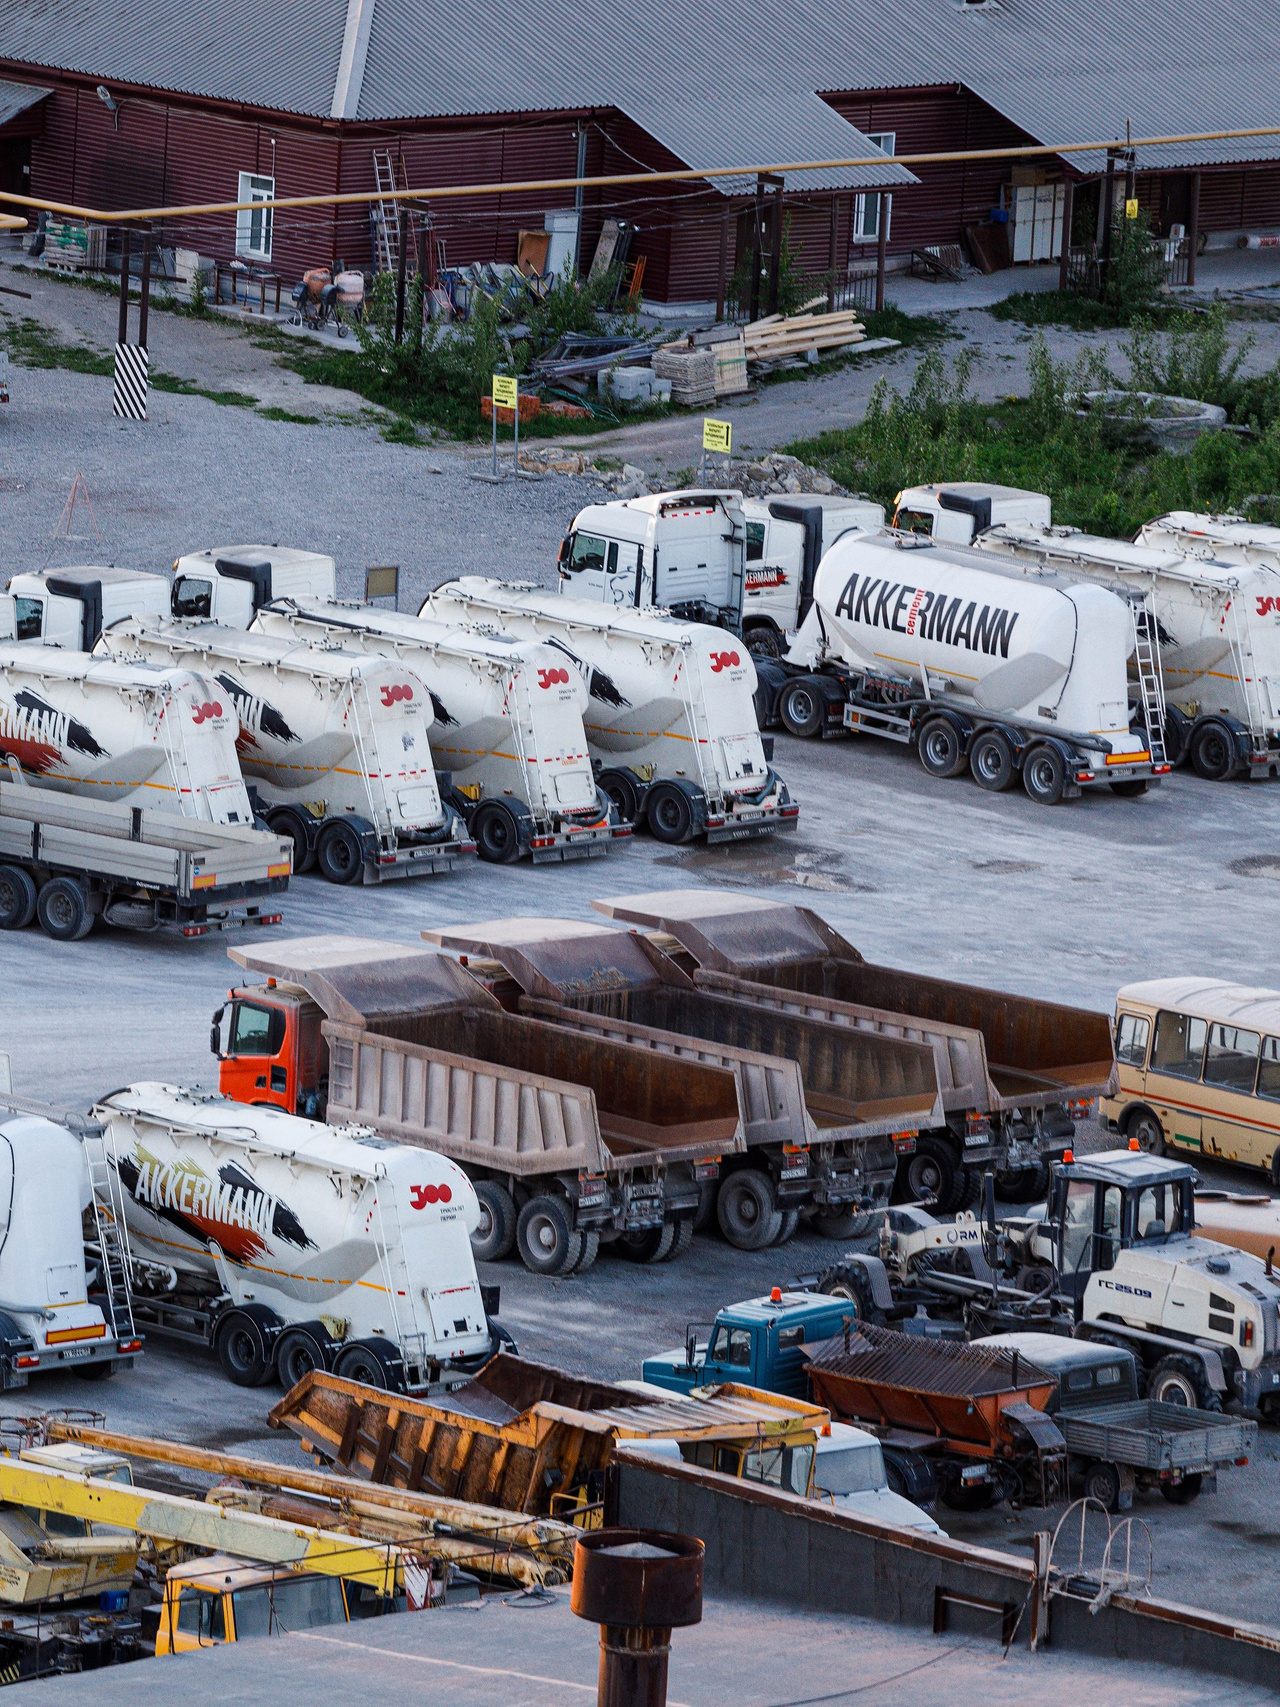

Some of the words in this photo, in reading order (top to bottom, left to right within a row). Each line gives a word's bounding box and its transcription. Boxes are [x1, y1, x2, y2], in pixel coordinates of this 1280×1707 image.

[745, 569, 777, 585] KERMANN
[835, 572, 1019, 659] AKKERMANN
[907, 588, 926, 636] cement
[134, 1161, 277, 1235] AKKERMANN
[1115, 1283, 1152, 1299] 25.09
